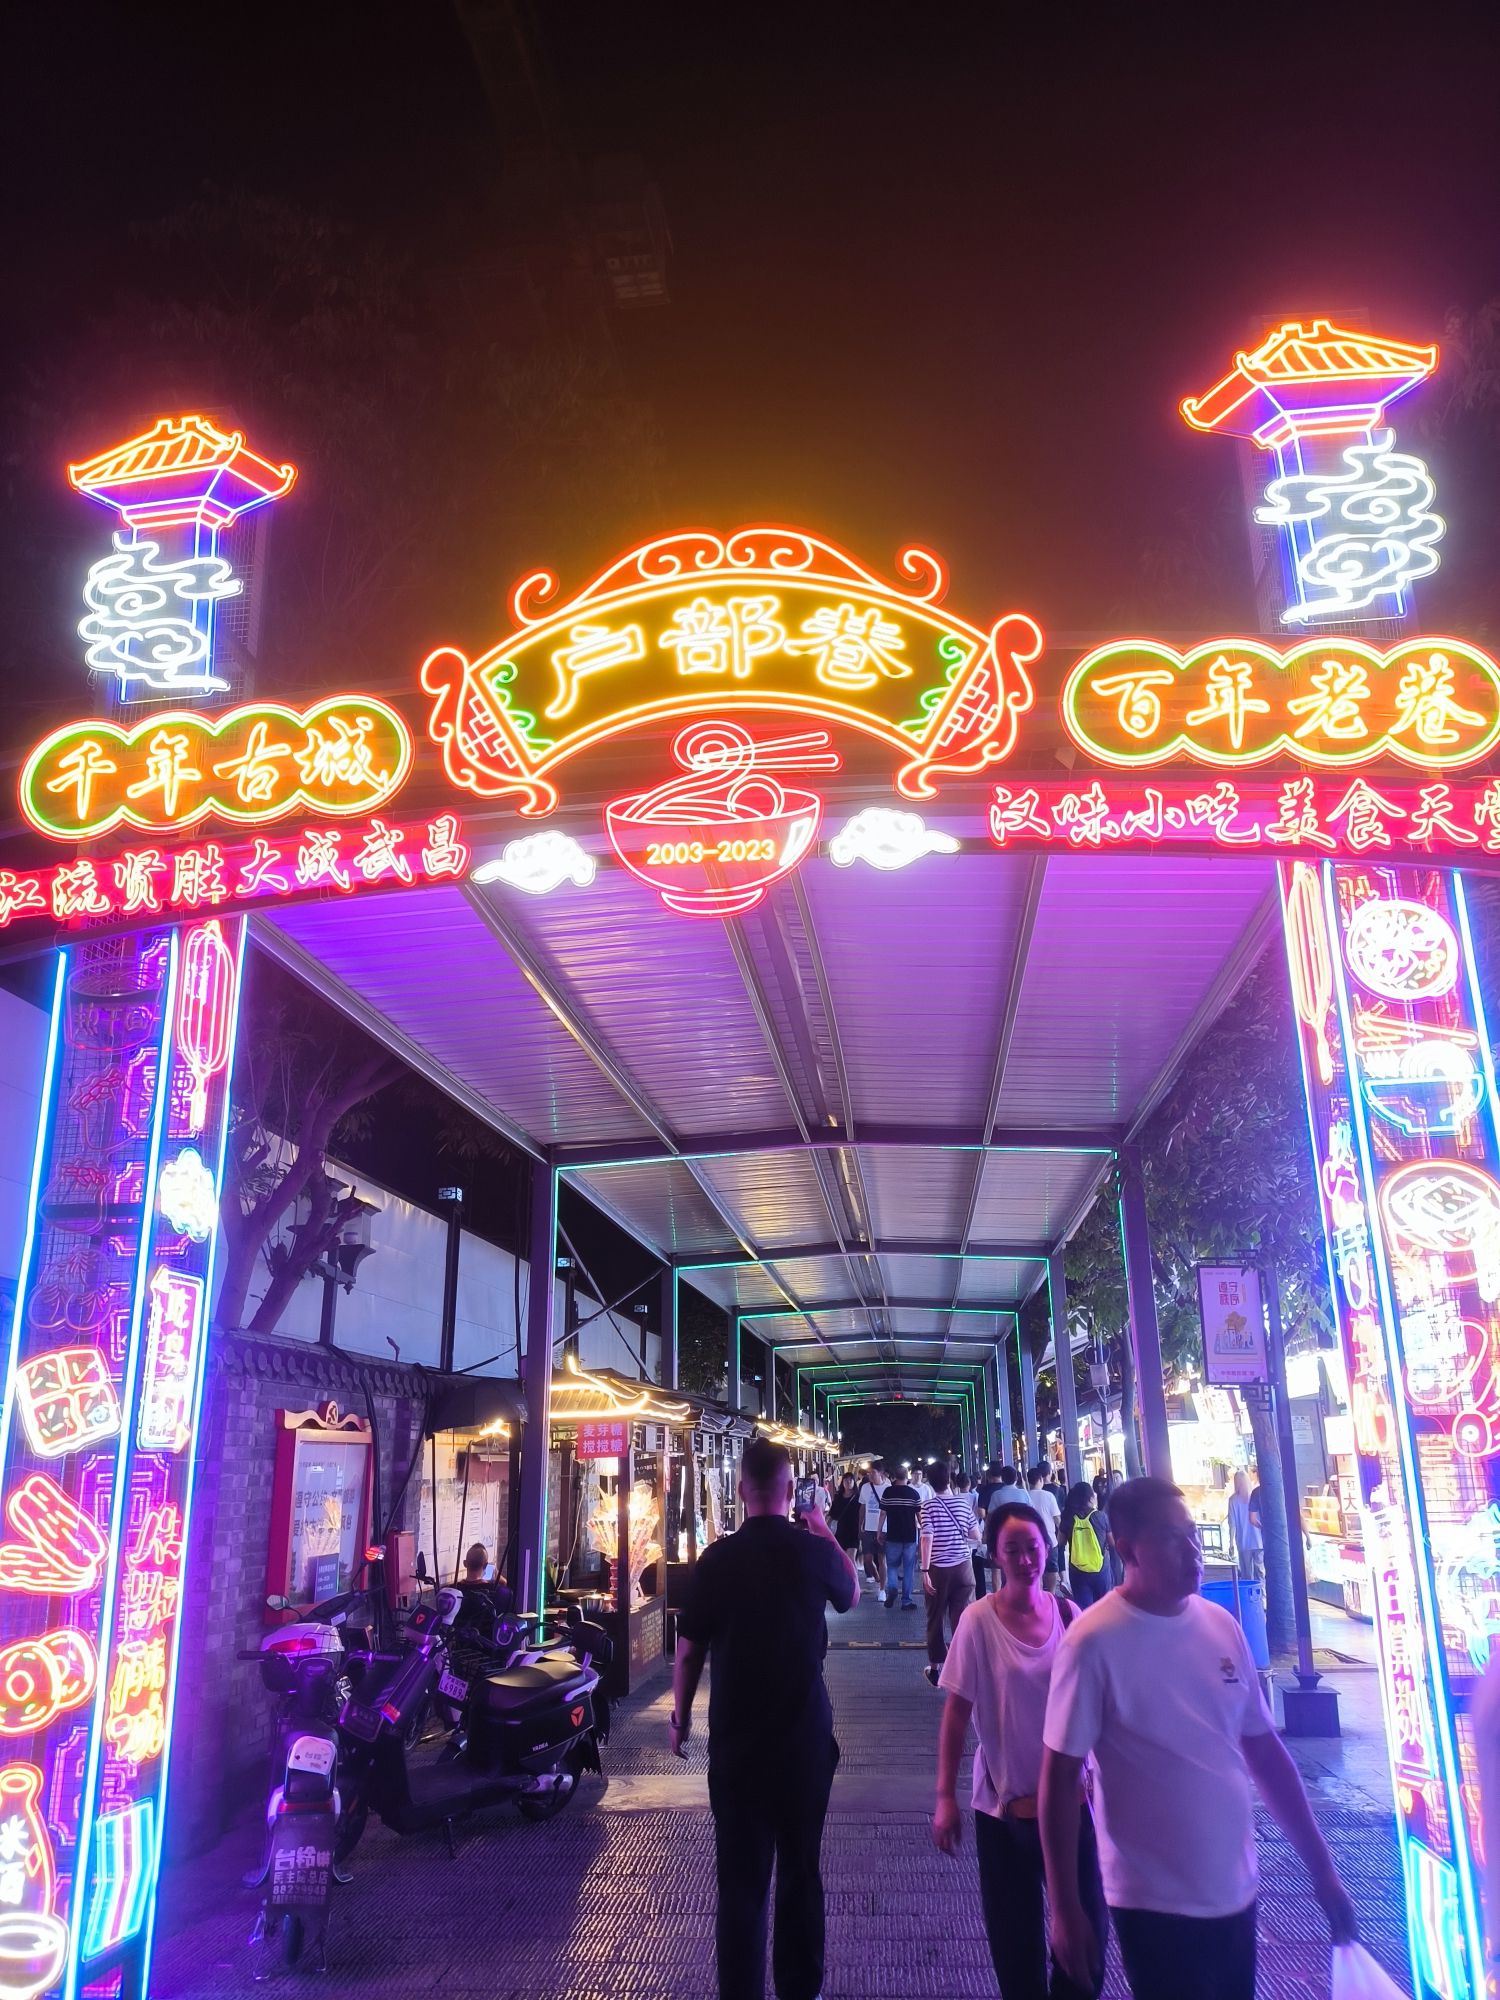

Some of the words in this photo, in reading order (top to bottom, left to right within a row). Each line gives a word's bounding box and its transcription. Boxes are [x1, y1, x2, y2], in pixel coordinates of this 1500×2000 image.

[546, 596, 912, 718] 户部巷
[1091, 653, 1487, 749] 百年老巷
[46, 714, 390, 819] 千年古城
[646, 839, 775, 865] 2003-2023
[583, 1423, 623, 1438] 麦芽糖
[583, 1439, 623, 1454] 搅搅糖
